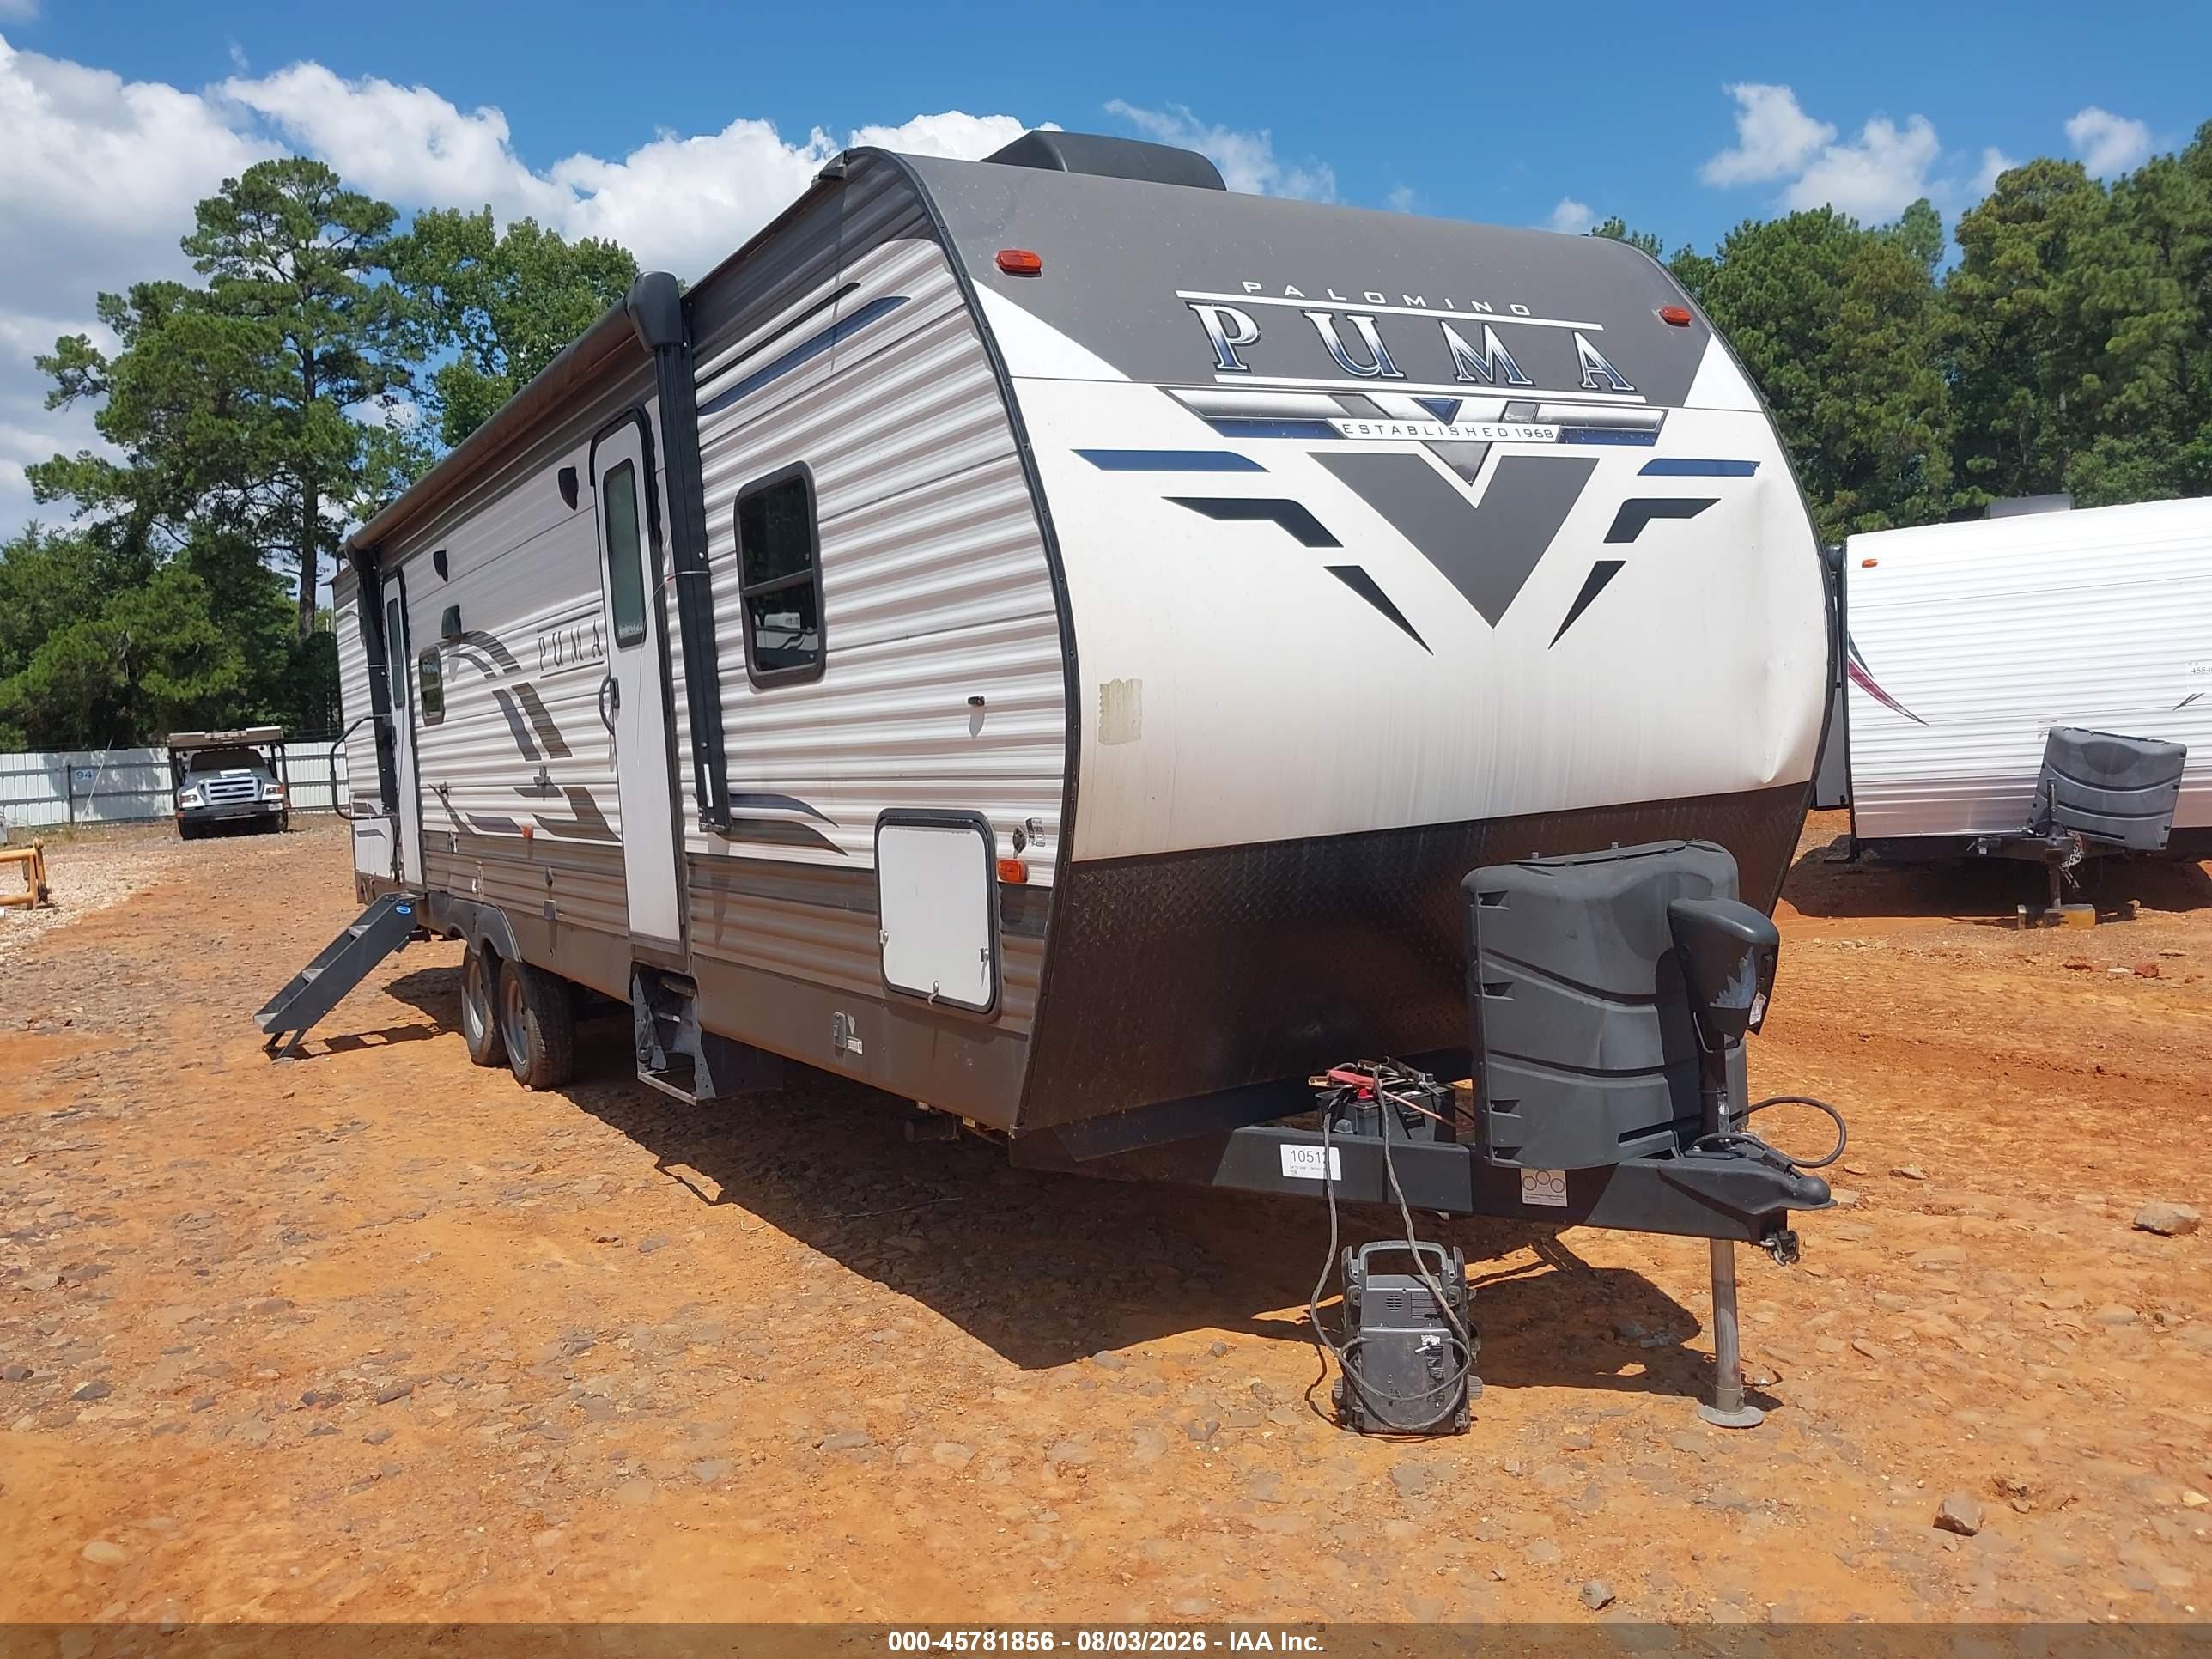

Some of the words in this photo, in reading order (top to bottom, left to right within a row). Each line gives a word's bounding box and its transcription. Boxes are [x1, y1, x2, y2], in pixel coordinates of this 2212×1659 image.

[1242, 281, 1531, 316] PALOMINO
[1186, 301, 1638, 392] PUMA
[1342, 423, 1509, 438] ESTABLISHED
[1515, 427, 1555, 439] 1968
[538, 619, 603, 671] PUMA
[1291, 1149, 1326, 1164] 1051
